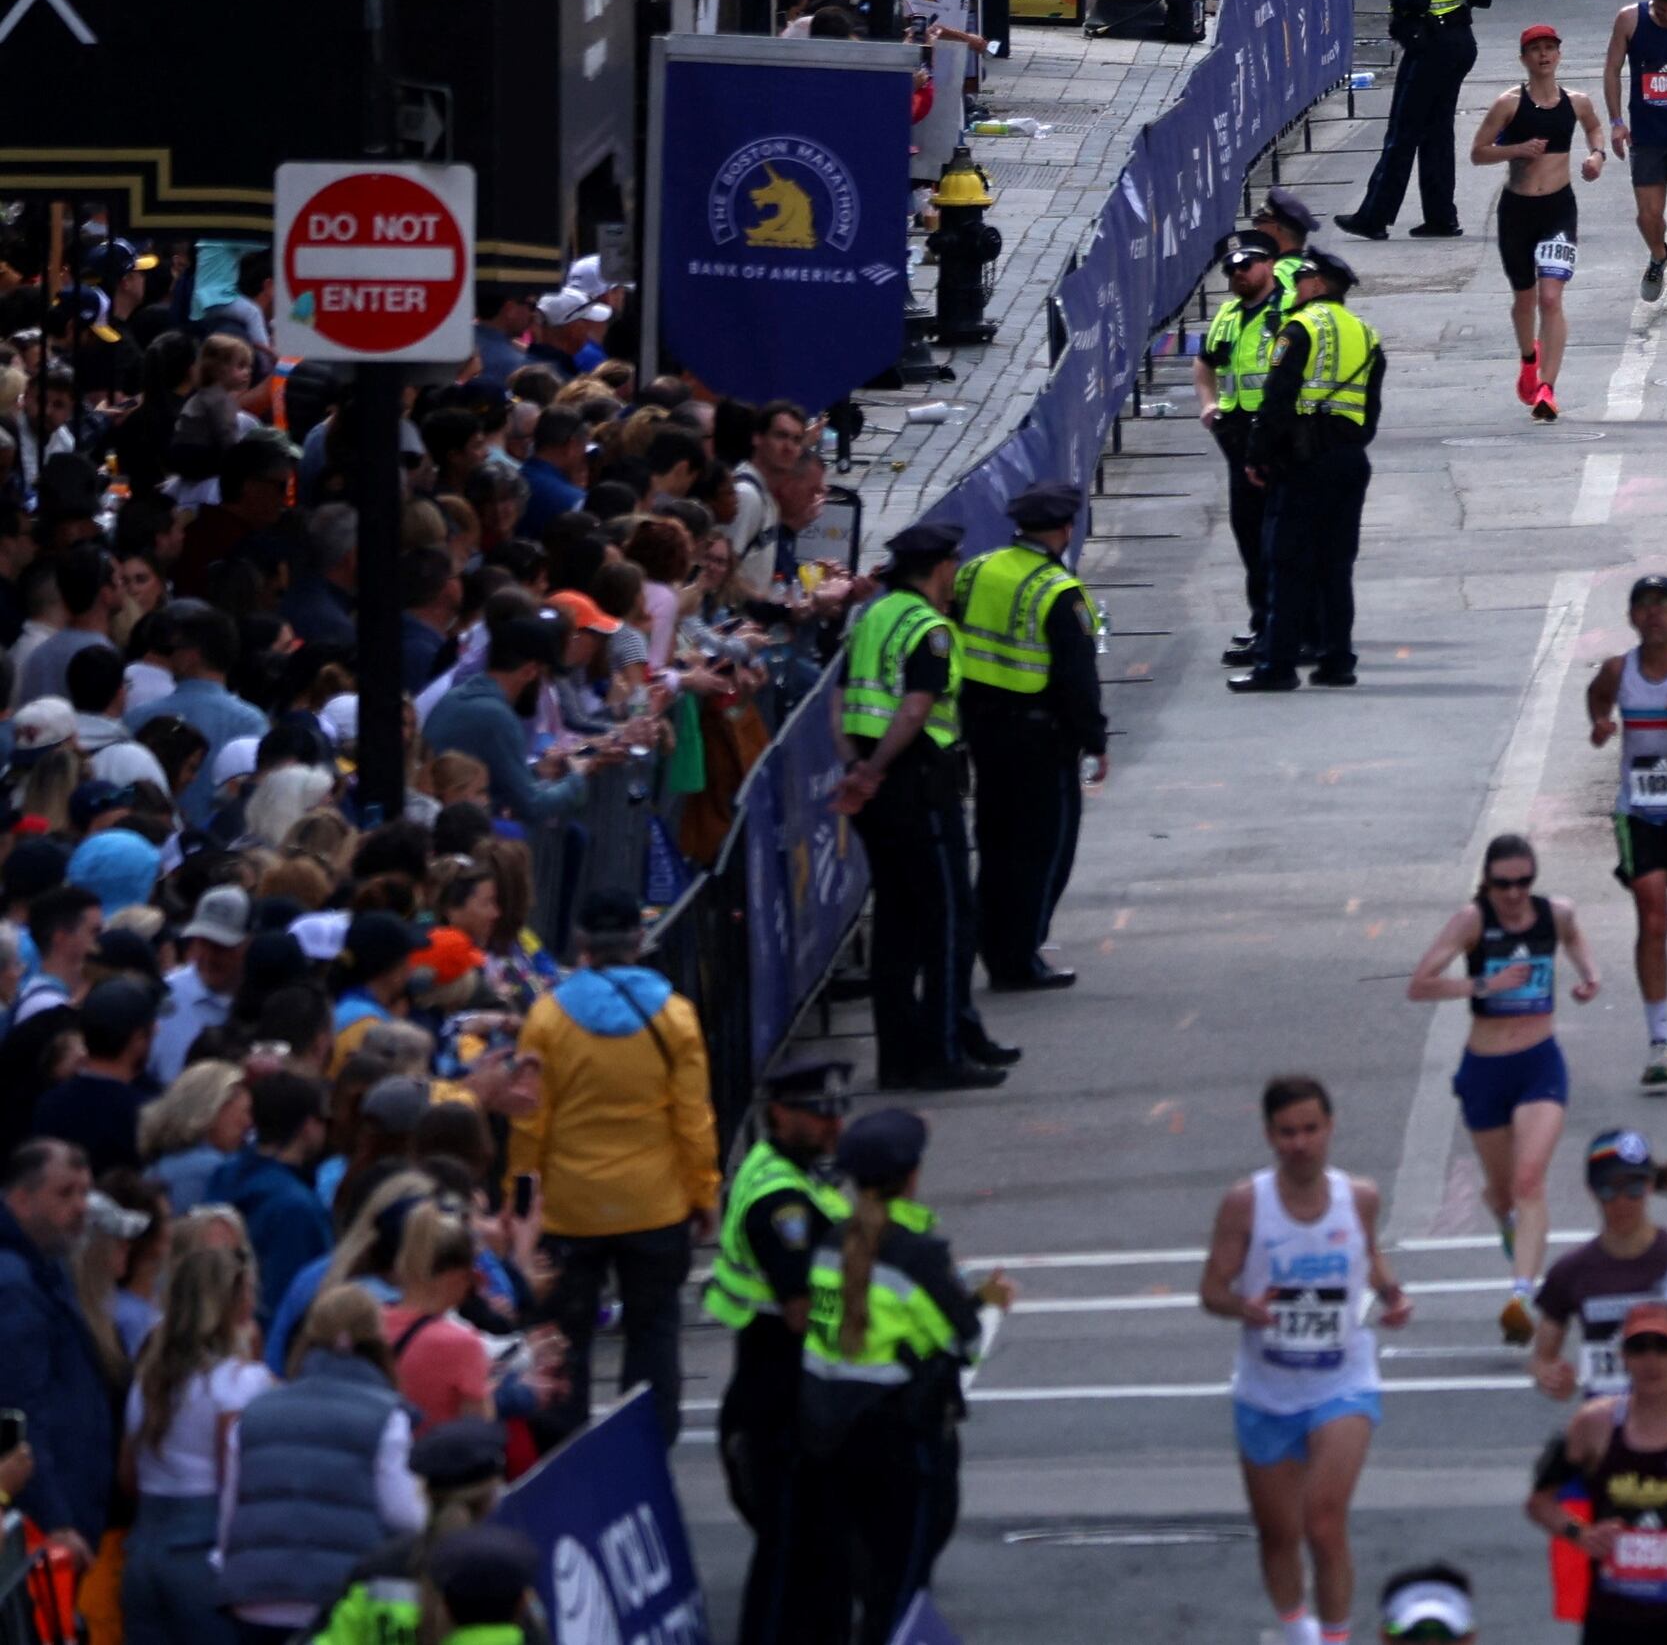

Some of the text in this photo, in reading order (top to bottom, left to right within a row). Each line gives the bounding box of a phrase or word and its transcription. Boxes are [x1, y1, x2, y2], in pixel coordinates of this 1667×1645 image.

[715, 142, 854, 236] THE BOSTON MARATHON
[309, 215, 439, 241] DO NOT
[688, 261, 857, 284] BANK OF AMERICA
[322, 286, 426, 313] ENTER
